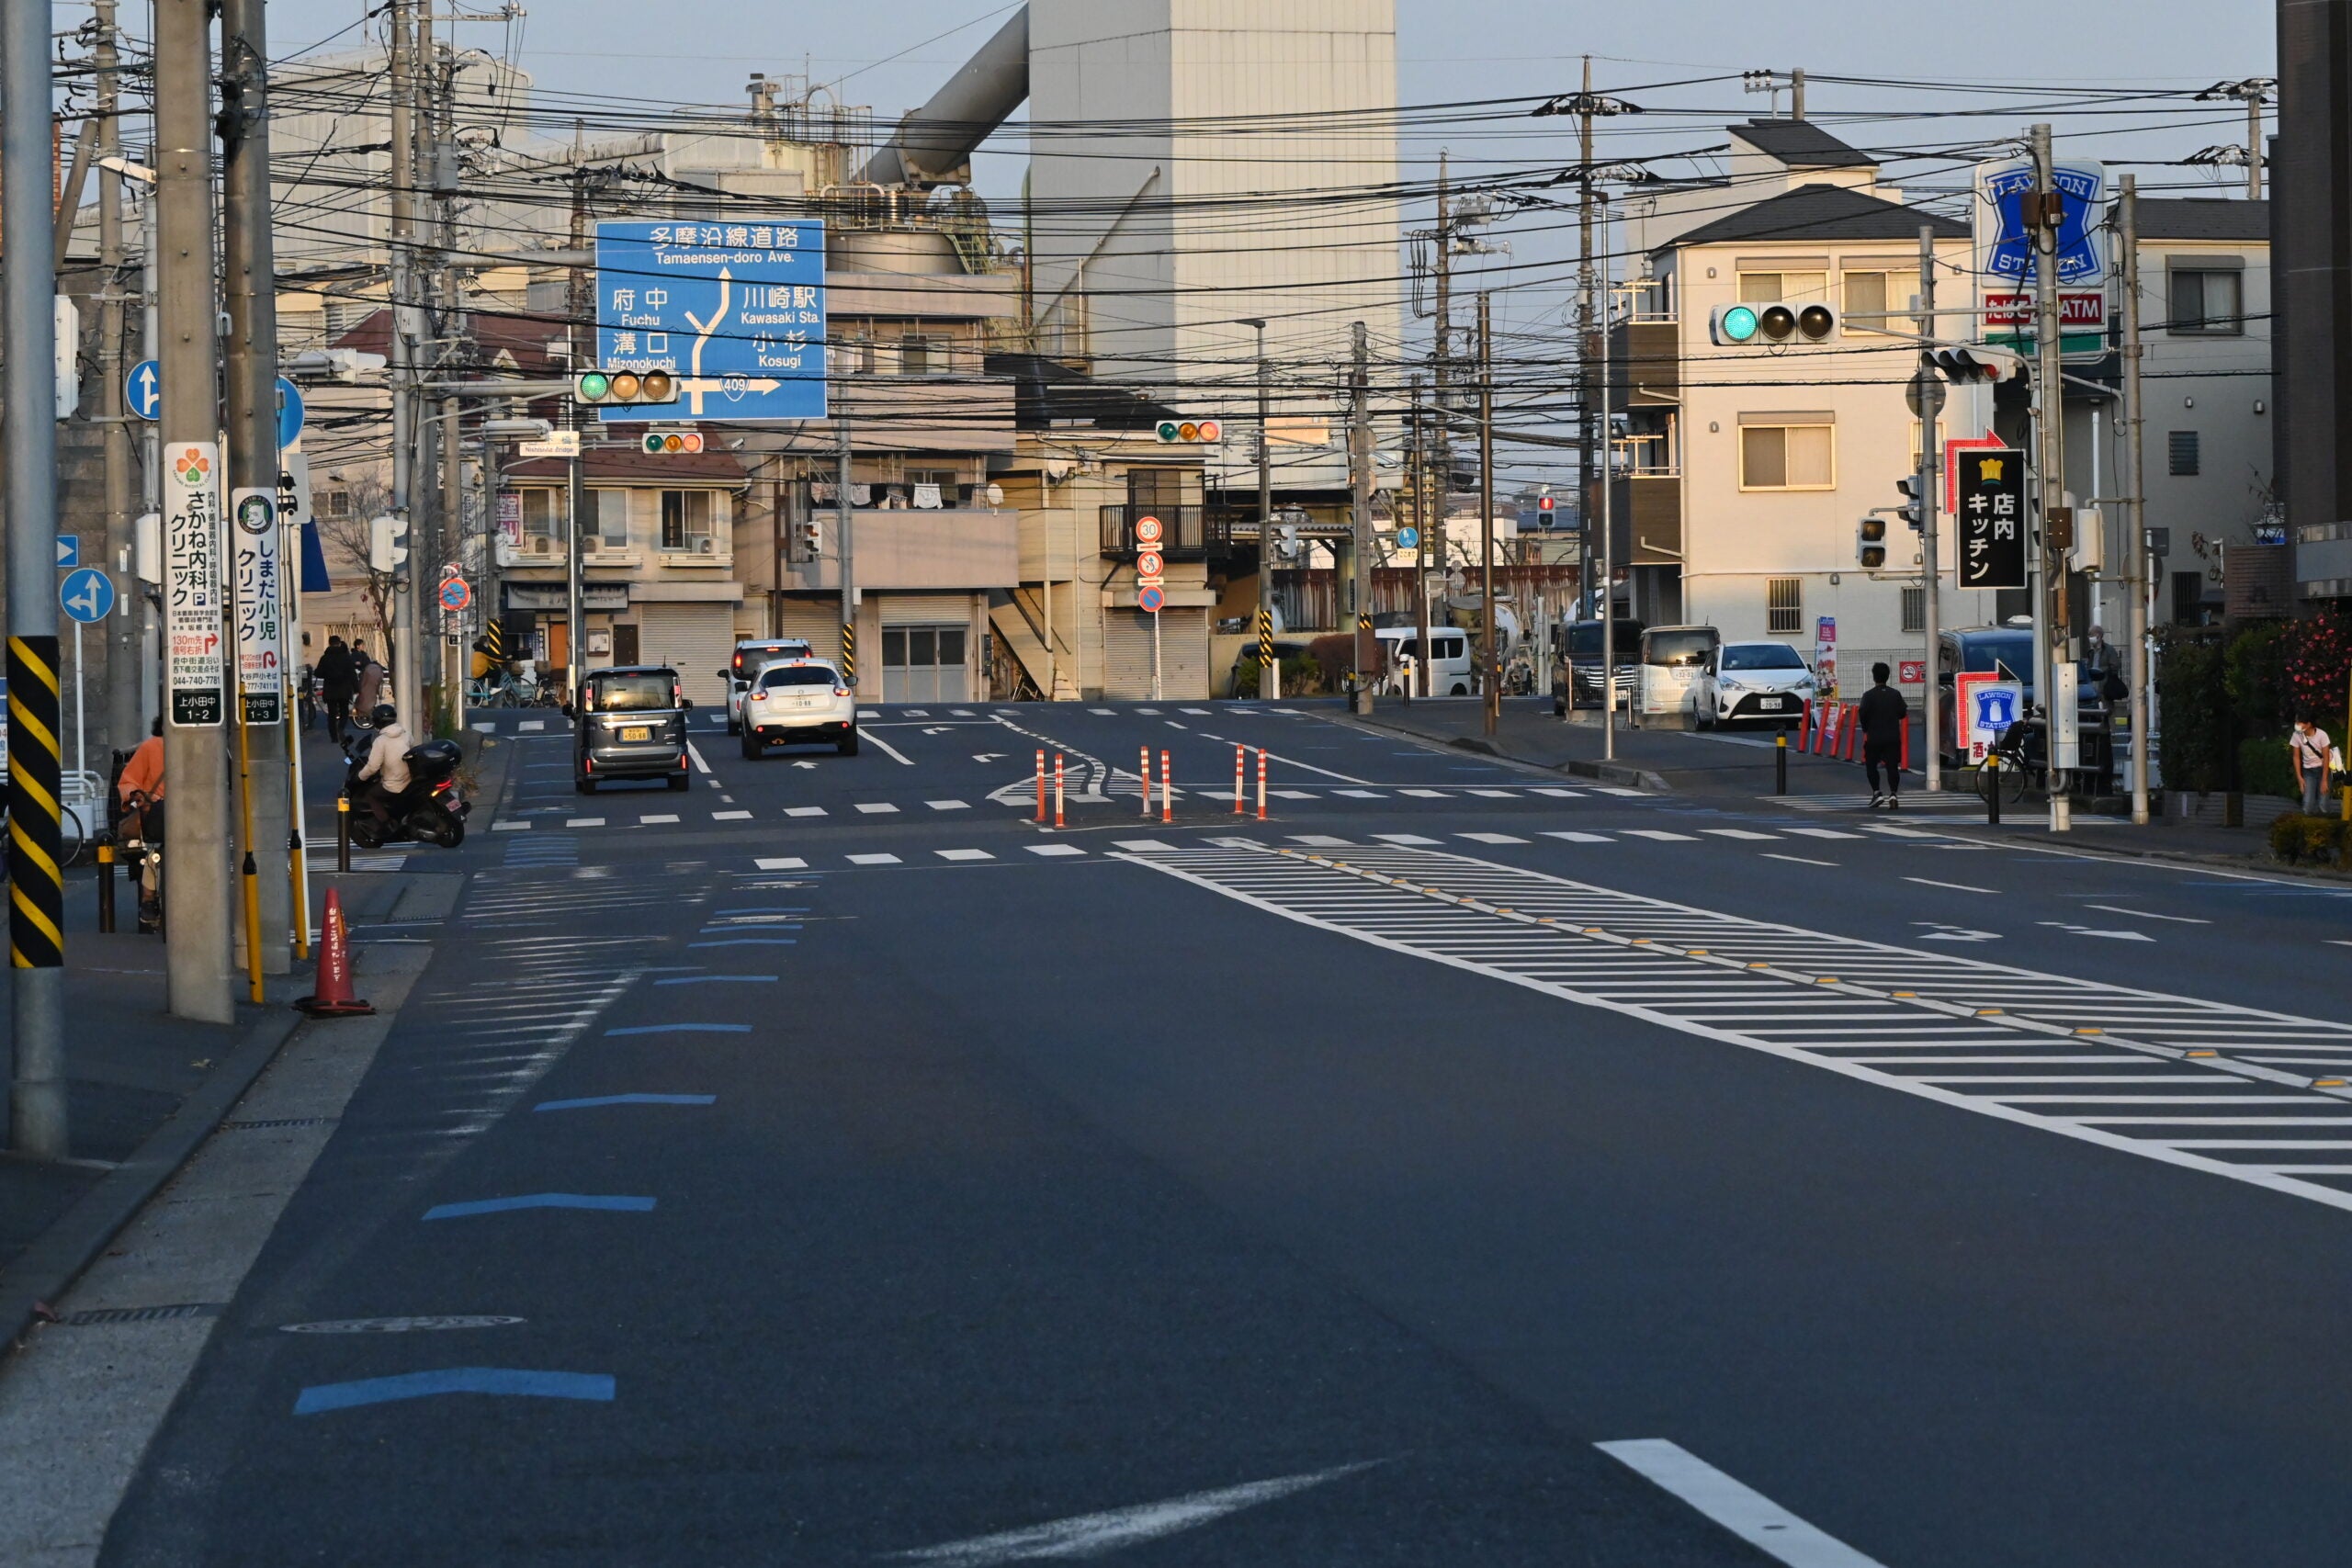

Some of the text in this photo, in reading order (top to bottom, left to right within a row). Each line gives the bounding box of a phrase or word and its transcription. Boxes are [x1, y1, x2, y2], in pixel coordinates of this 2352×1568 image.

[650, 226, 798, 251] 多摩沿線道路
[655, 250, 795, 265] Tamaensen-doro Ave.
[613, 288, 668, 311] 府中
[742, 287, 817, 310] 川崎駅
[2060, 299, 2099, 318] ATM
[621, 314, 661, 326] Fuchu
[741, 311, 820, 324] Kawasaki Sta.
[613, 332, 668, 355] 溝口
[752, 330, 808, 353] 小杉
[607, 355, 676, 368] Mizonokuchi
[759, 355, 801, 368] Kosugi
[723, 378, 745, 390] 409
[1993, 493, 2015, 540] 店内
[1142, 524, 1157, 536] 30
[1968, 493, 1989, 580] キッチン
[187, 491, 208, 589] さかね内科
[171, 513, 188, 606] クリニック
[238, 548, 256, 641] クリニック
[258, 539, 277, 640] しまだ小児
[173, 635, 202, 645] 130m先
[173, 646, 202, 655] 信号右折
[173, 657, 220, 665] 府中街道沿い
[173, 676, 220, 685] 044-740-7781
[179, 696, 216, 707] 上小田中
[1978, 691, 2012, 700] LAWSON
[245, 699, 275, 708] 上小田中
[187, 709, 209, 720] 1-2
[250, 710, 269, 719] 1-3
[1979, 720, 2012, 728] STATION
